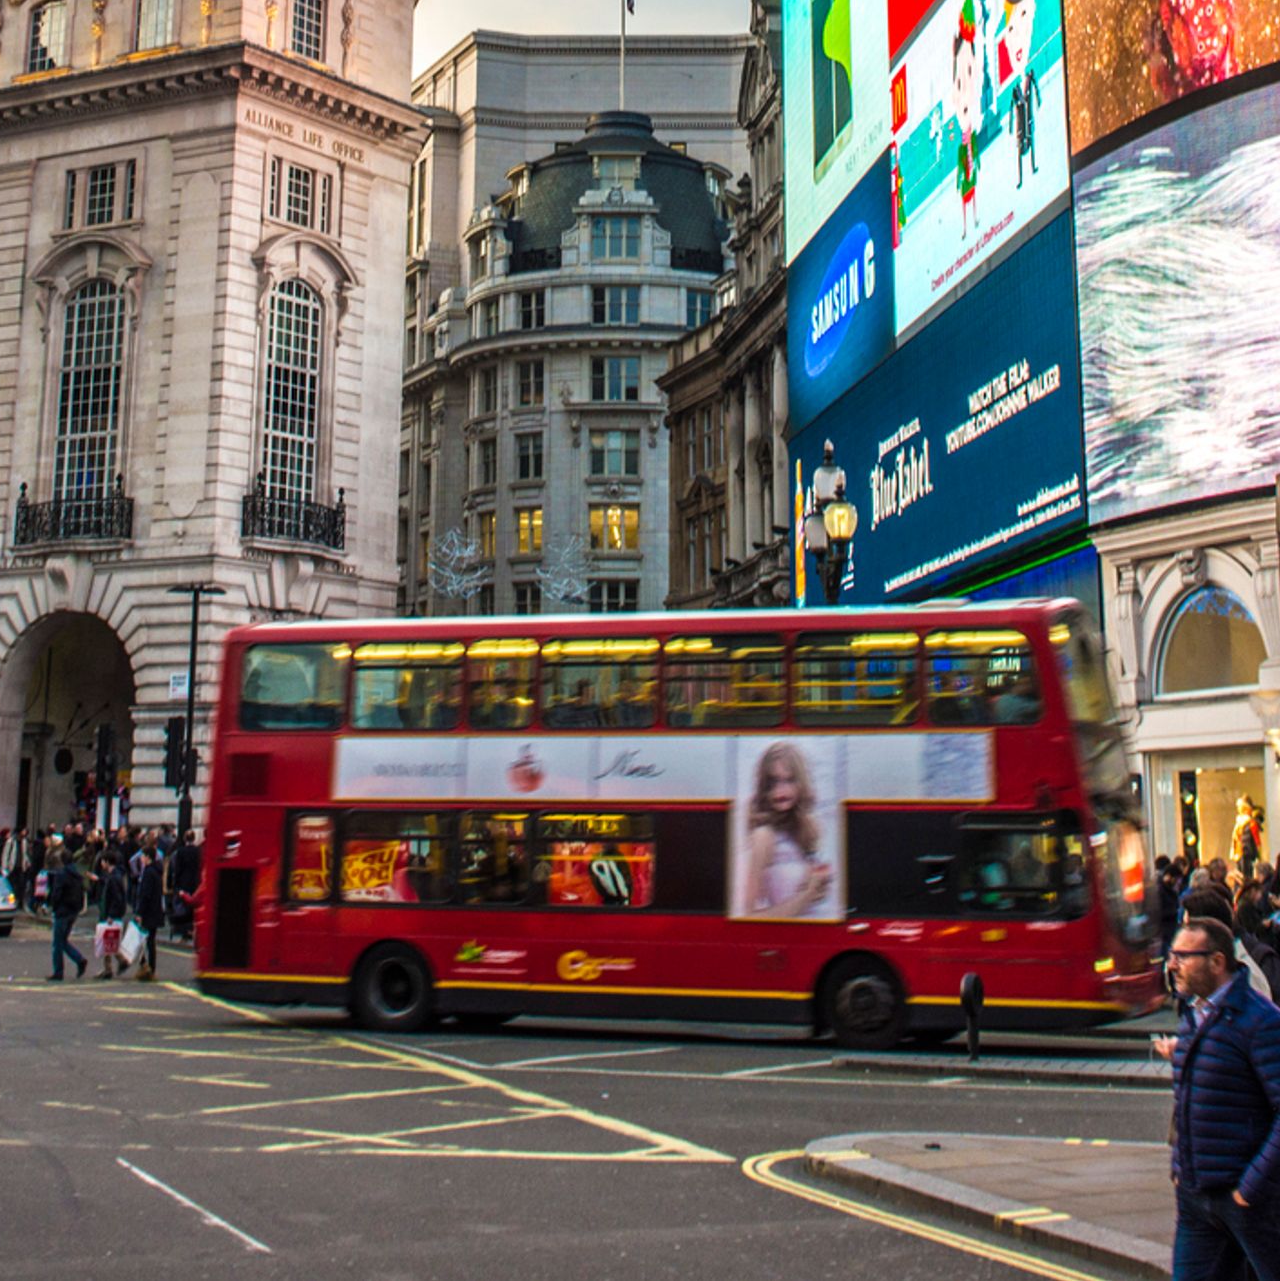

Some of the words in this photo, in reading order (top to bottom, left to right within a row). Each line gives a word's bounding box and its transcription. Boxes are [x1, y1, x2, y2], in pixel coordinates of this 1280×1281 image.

[245, 108, 294, 138] ALLIANCE
[302, 128, 323, 149] LIFE
[332, 139, 365, 163] OFFICE
[811, 238, 876, 345] SAMSUNG
[968, 383, 992, 415] WATCH
[991, 370, 1008, 401] THE
[1027, 362, 1061, 405] WALKER
[870, 462, 897, 532] Blue
